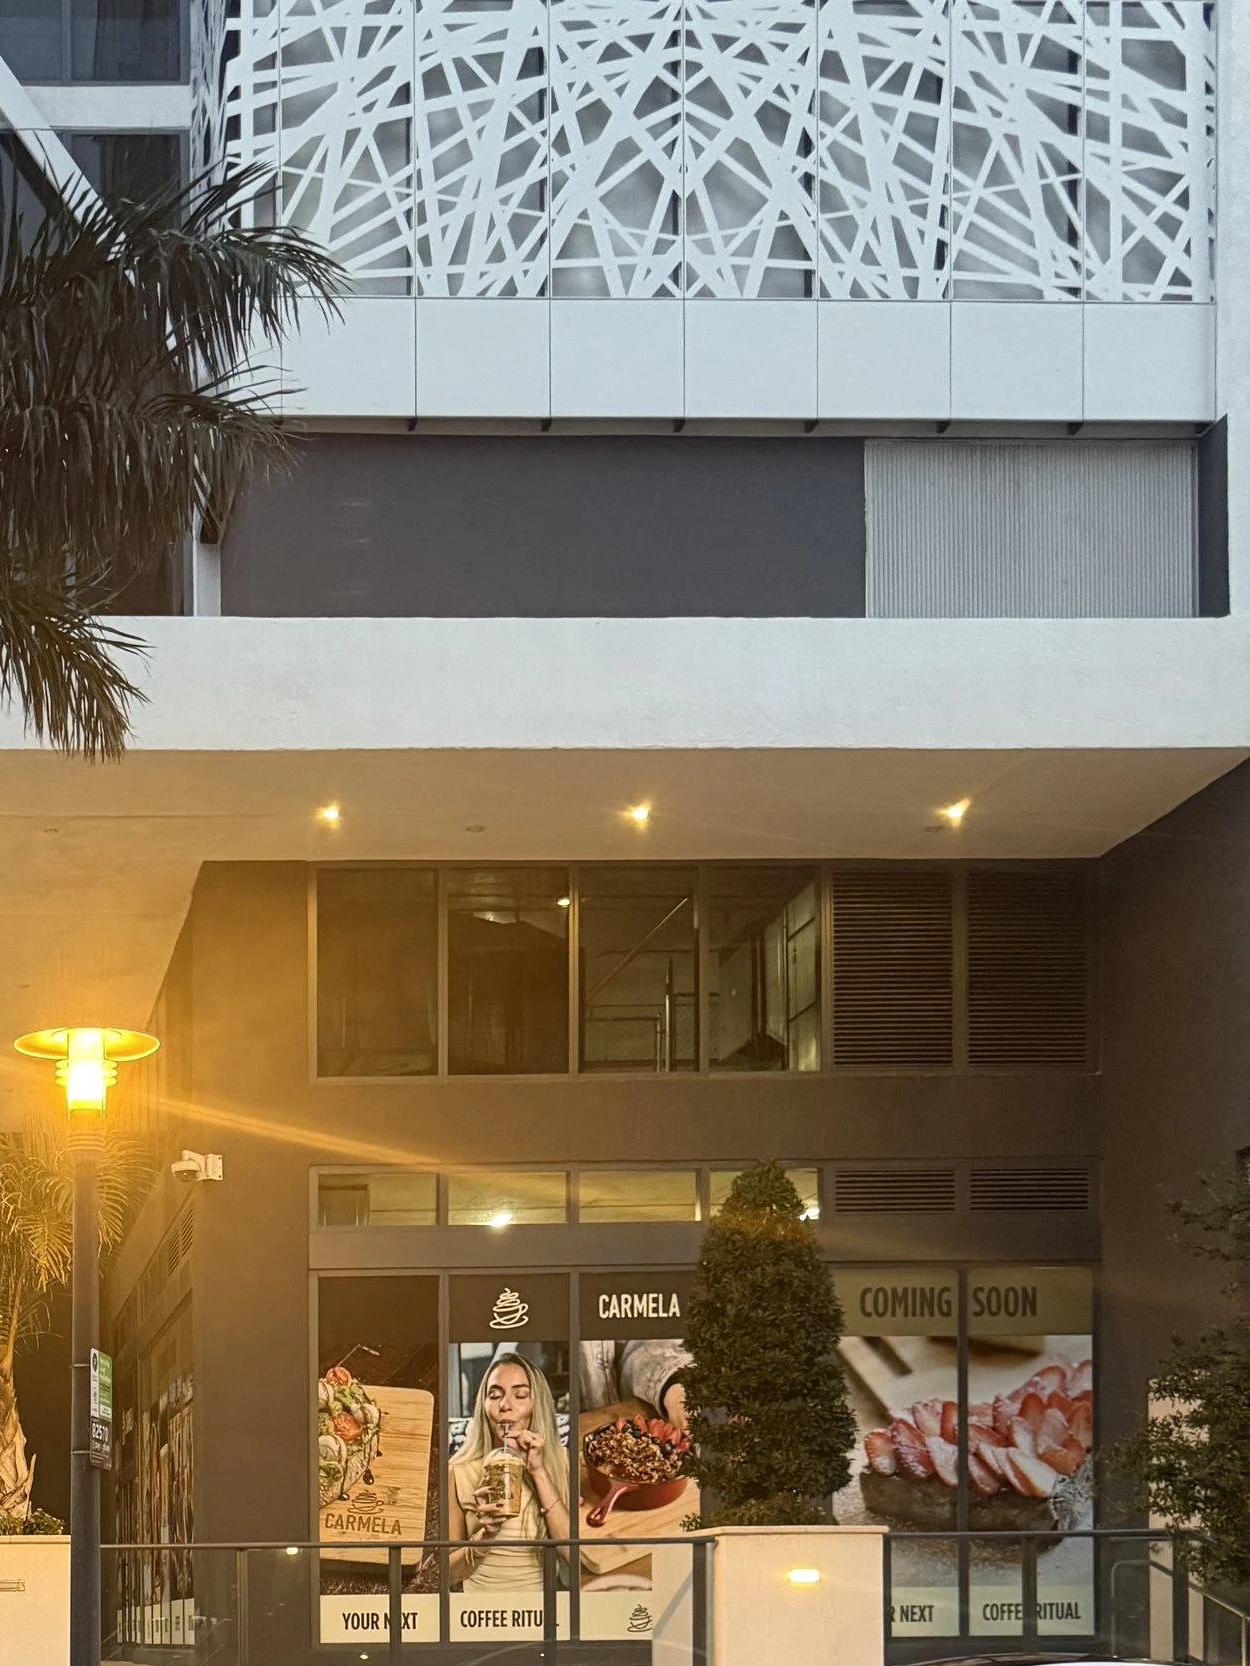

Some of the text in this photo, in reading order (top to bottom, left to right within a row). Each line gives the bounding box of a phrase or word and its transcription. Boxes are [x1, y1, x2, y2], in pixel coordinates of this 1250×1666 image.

[598, 1292, 681, 1319] CARMELA
[859, 1286, 1038, 1318] COMING SOON
[324, 1512, 402, 1536] CARMELA
[460, 1609, 560, 1628] COFFEE RITU
[900, 1605, 935, 1623] NEXT
[982, 1602, 1082, 1621] COFFE RITUAL
[341, 1612, 418, 1631] YOUR NXT
